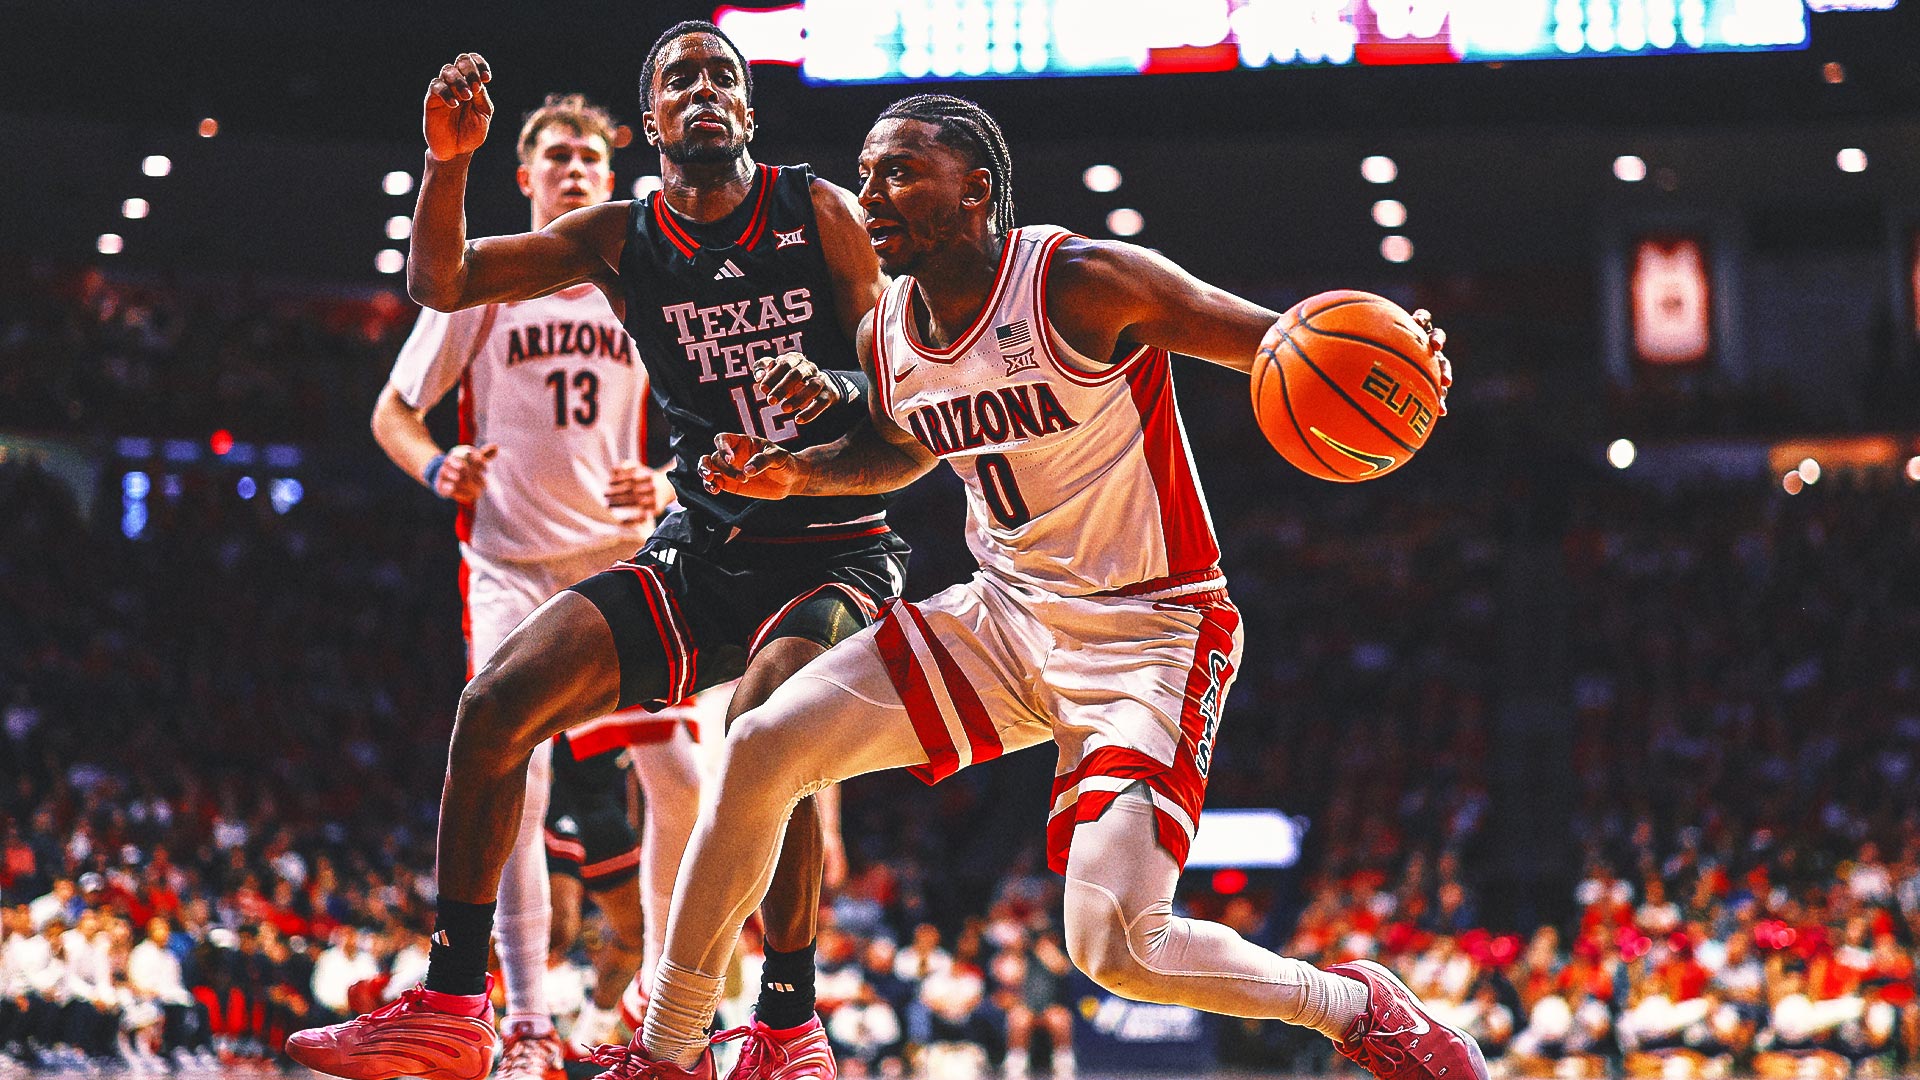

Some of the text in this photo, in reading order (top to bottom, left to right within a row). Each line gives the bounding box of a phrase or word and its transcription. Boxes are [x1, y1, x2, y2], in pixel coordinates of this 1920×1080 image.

[507, 321, 633, 367] ARIZONA
[662, 288, 812, 344] TEXAS
[546, 369, 600, 429] 13
[1361, 366, 1433, 438] ELITE
[975, 453, 1031, 530] 0
[1195, 650, 1228, 779] CATS
